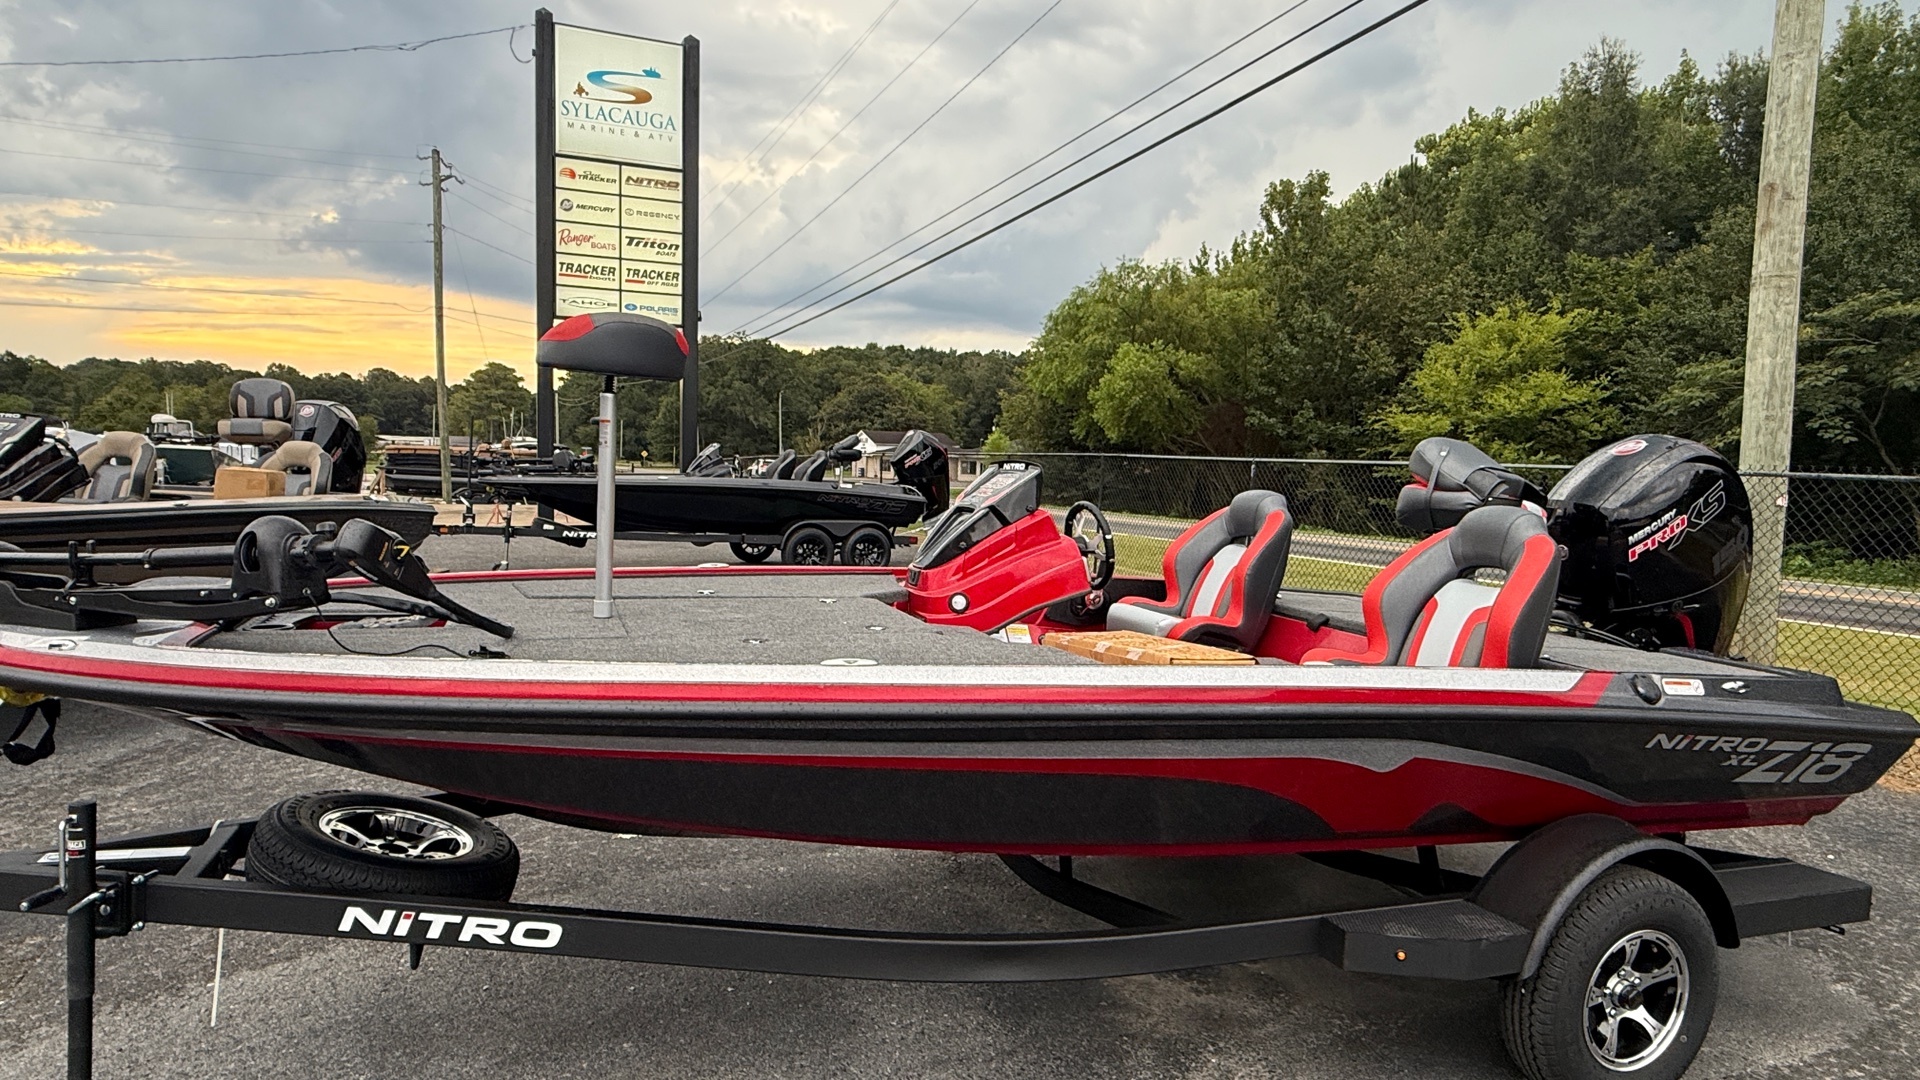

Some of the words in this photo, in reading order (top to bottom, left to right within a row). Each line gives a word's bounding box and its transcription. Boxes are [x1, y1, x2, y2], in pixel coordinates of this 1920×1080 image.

[561, 100, 677, 132] SYLACAUGA
[567, 121, 625, 136] MARINE
[648, 133, 673, 142] ATV
[578, 174, 617, 185] TRACKER
[576, 203, 616, 213] MERCURY
[636, 210, 680, 220] REGENCY
[558, 228, 594, 246] Ranger
[625, 236, 680, 251] Triton
[591, 242, 616, 251] BOATS
[559, 262, 616, 277] TRACKER
[626, 268, 680, 282] TRACKER
[559, 298, 617, 308] TAHOE
[639, 305, 678, 314] POLARIS
[1628, 514, 1688, 562] PRO
[1667, 479, 1726, 551] XS
[1628, 508, 1677, 545] MERCURY
[562, 530, 598, 539] NITR
[1720, 754, 1760, 767] XL
[1731, 740, 1873, 784] Z18
